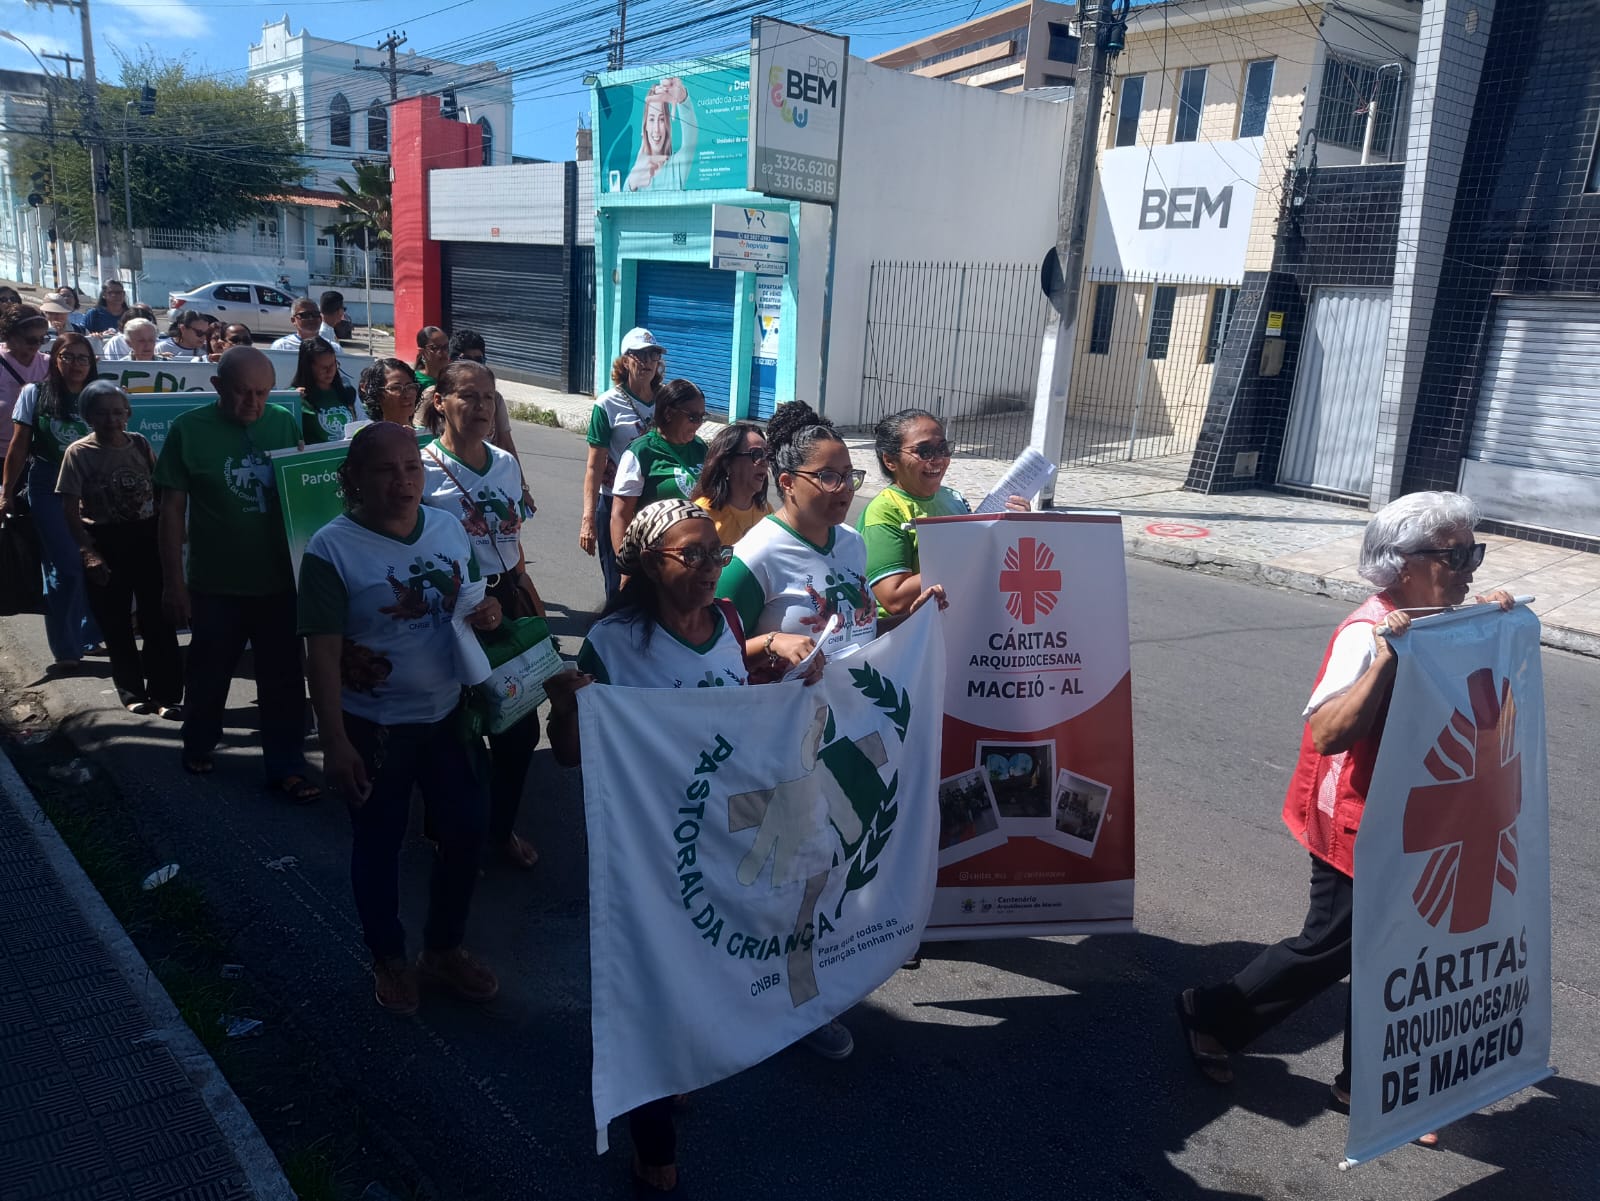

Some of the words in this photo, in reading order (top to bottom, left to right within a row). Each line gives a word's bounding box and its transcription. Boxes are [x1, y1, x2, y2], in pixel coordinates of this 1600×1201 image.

[808, 55, 838, 79] PRO
[734, 80, 750, 91] Den
[786, 68, 838, 109] BEM
[761, 163, 774, 175] 82
[774, 154, 836, 178] 3326.6210
[774, 172, 835, 196] 3316.5815
[1138, 185, 1234, 230] BEM
[140, 418, 165, 430] Área
[301, 468, 343, 486] Paróq
[988, 627, 1068, 651] CÁRITAS
[968, 652, 1082, 670] ARQUIDIOCESANA
[967, 674, 1044, 699] MACEIÓ
[1060, 677, 1084, 695] AL
[673, 733, 734, 910] PASTORAL
[692, 903, 725, 947] DA
[726, 911, 835, 961] CRIANÇA
[818, 943, 839, 957] Para
[840, 934, 855, 949] que
[856, 921, 883, 938] todas
[885, 917, 898, 928] as
[818, 946, 856, 969] crianças
[857, 931, 895, 952] tenham
[896, 923, 915, 937] vida
[1383, 925, 1528, 1013] CÁRITAS
[750, 972, 782, 998] CNBB
[1382, 975, 1530, 1062] ARQUIDIOCESANA
[1381, 1062, 1420, 1115] DE
[1428, 1008, 1524, 1096] MACEIÓ
